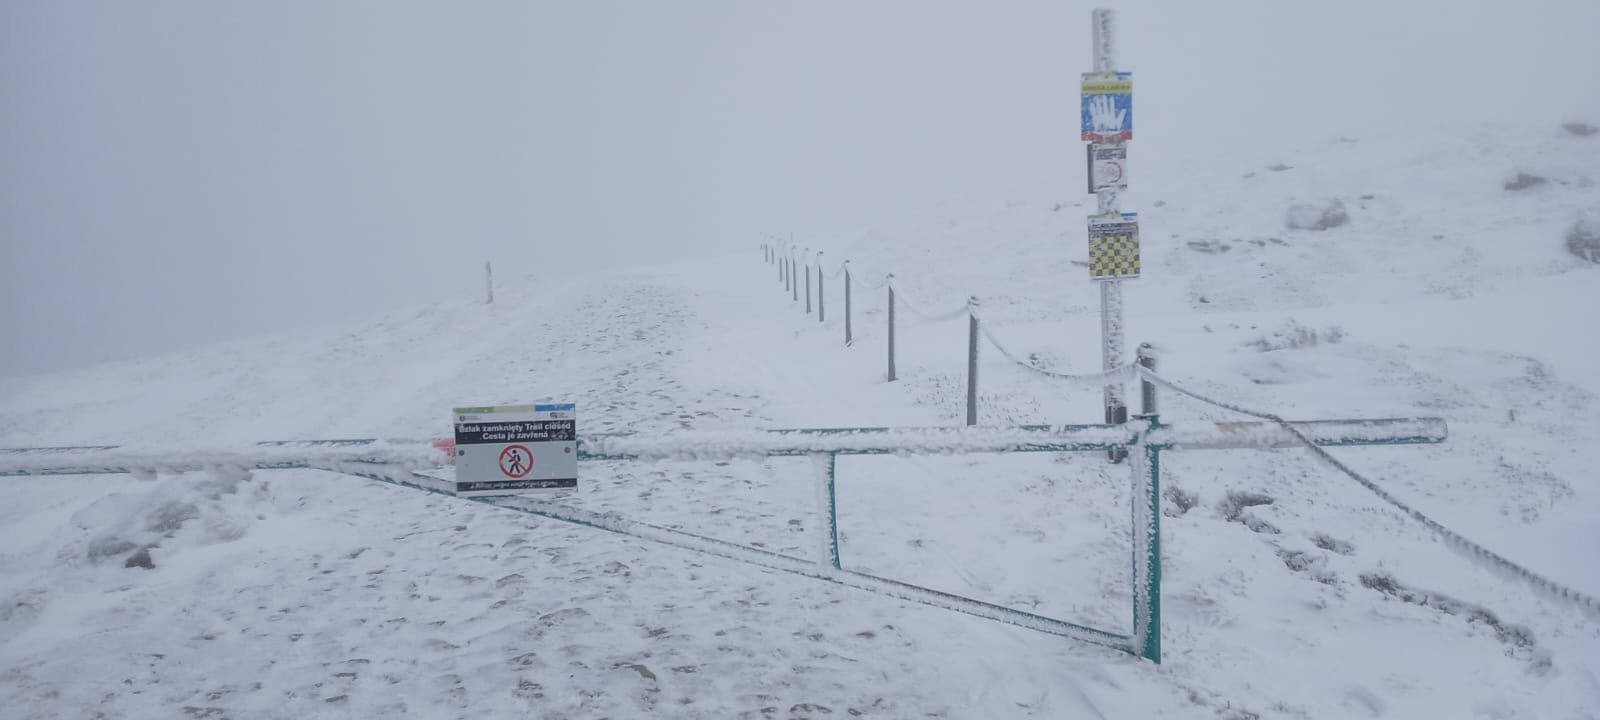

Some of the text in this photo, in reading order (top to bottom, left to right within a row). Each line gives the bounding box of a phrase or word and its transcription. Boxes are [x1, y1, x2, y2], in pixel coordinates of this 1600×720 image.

[544, 422, 571, 430] closed
[482, 432, 506, 440] Cesta
[507, 432, 515, 441] je
